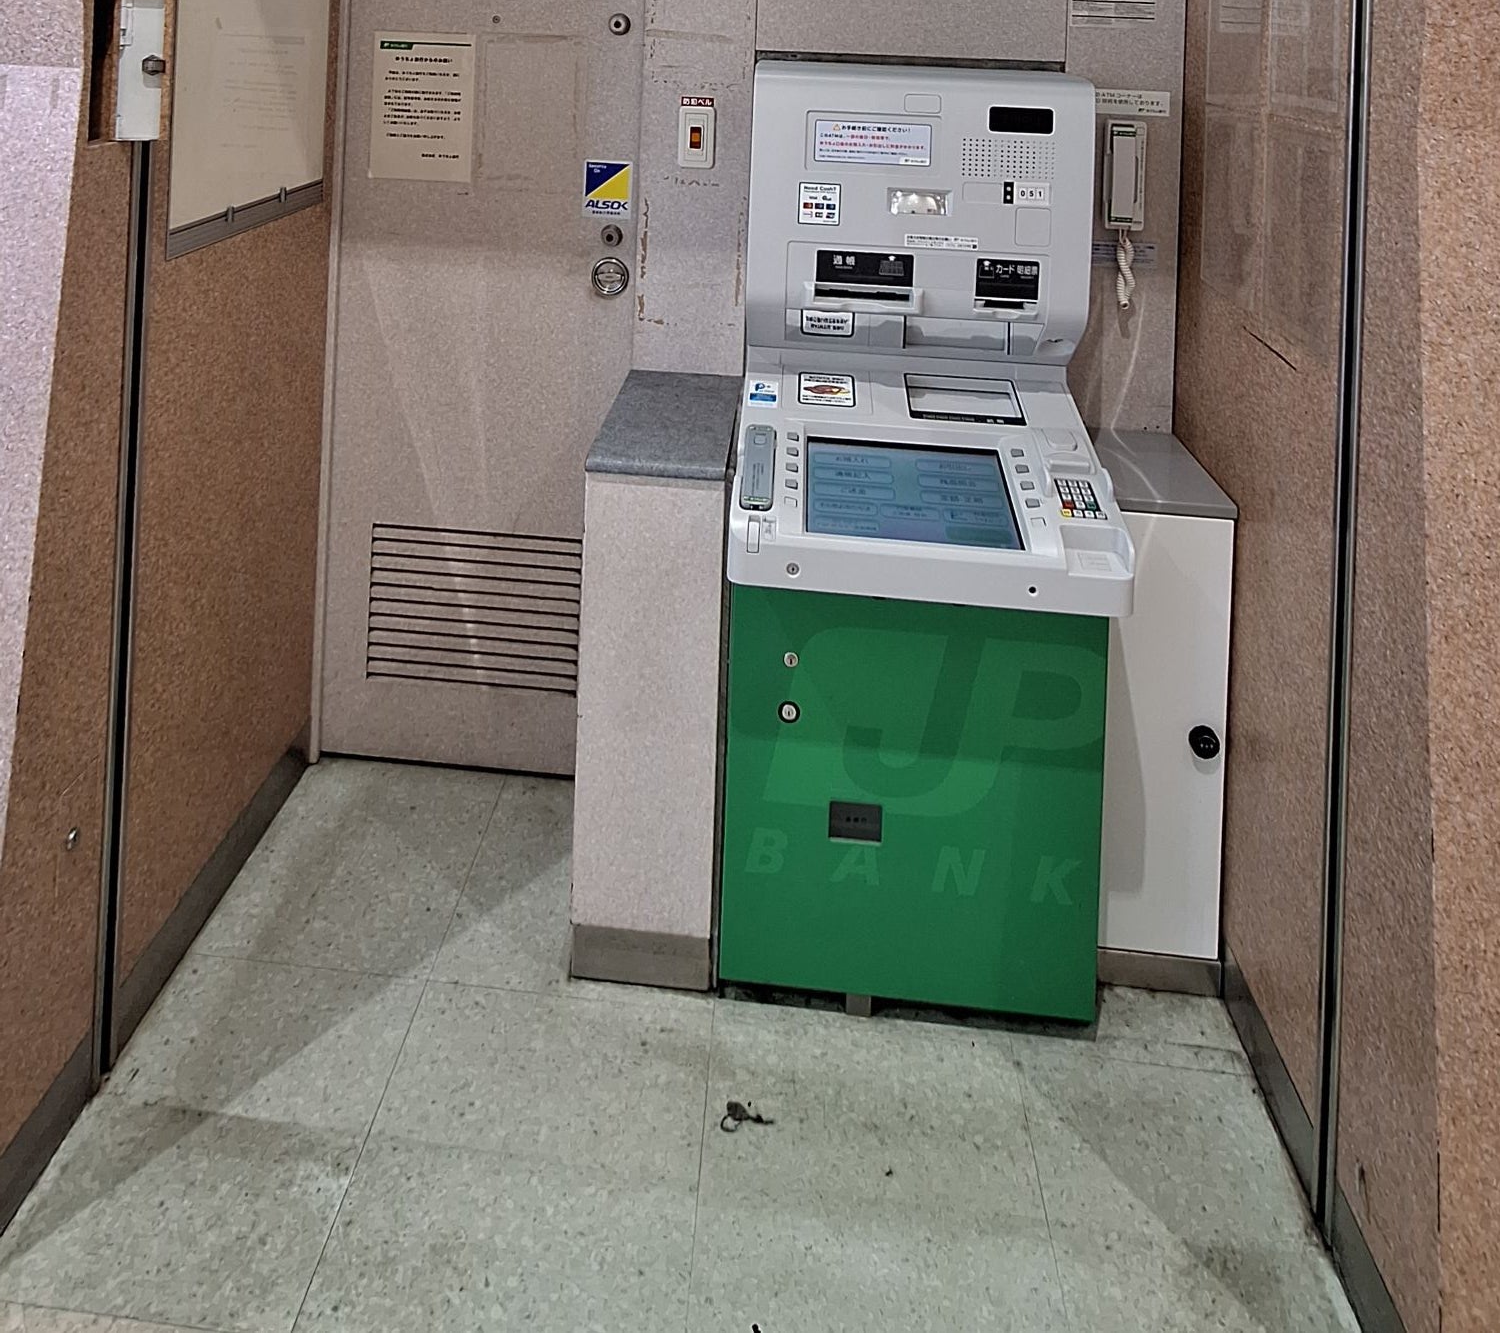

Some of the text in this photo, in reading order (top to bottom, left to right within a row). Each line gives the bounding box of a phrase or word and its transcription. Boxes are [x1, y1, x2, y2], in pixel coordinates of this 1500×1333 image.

[585, 199, 628, 210] ALSOK
[995, 264, 1015, 274] カード
[745, 828, 1082, 906] BANK
